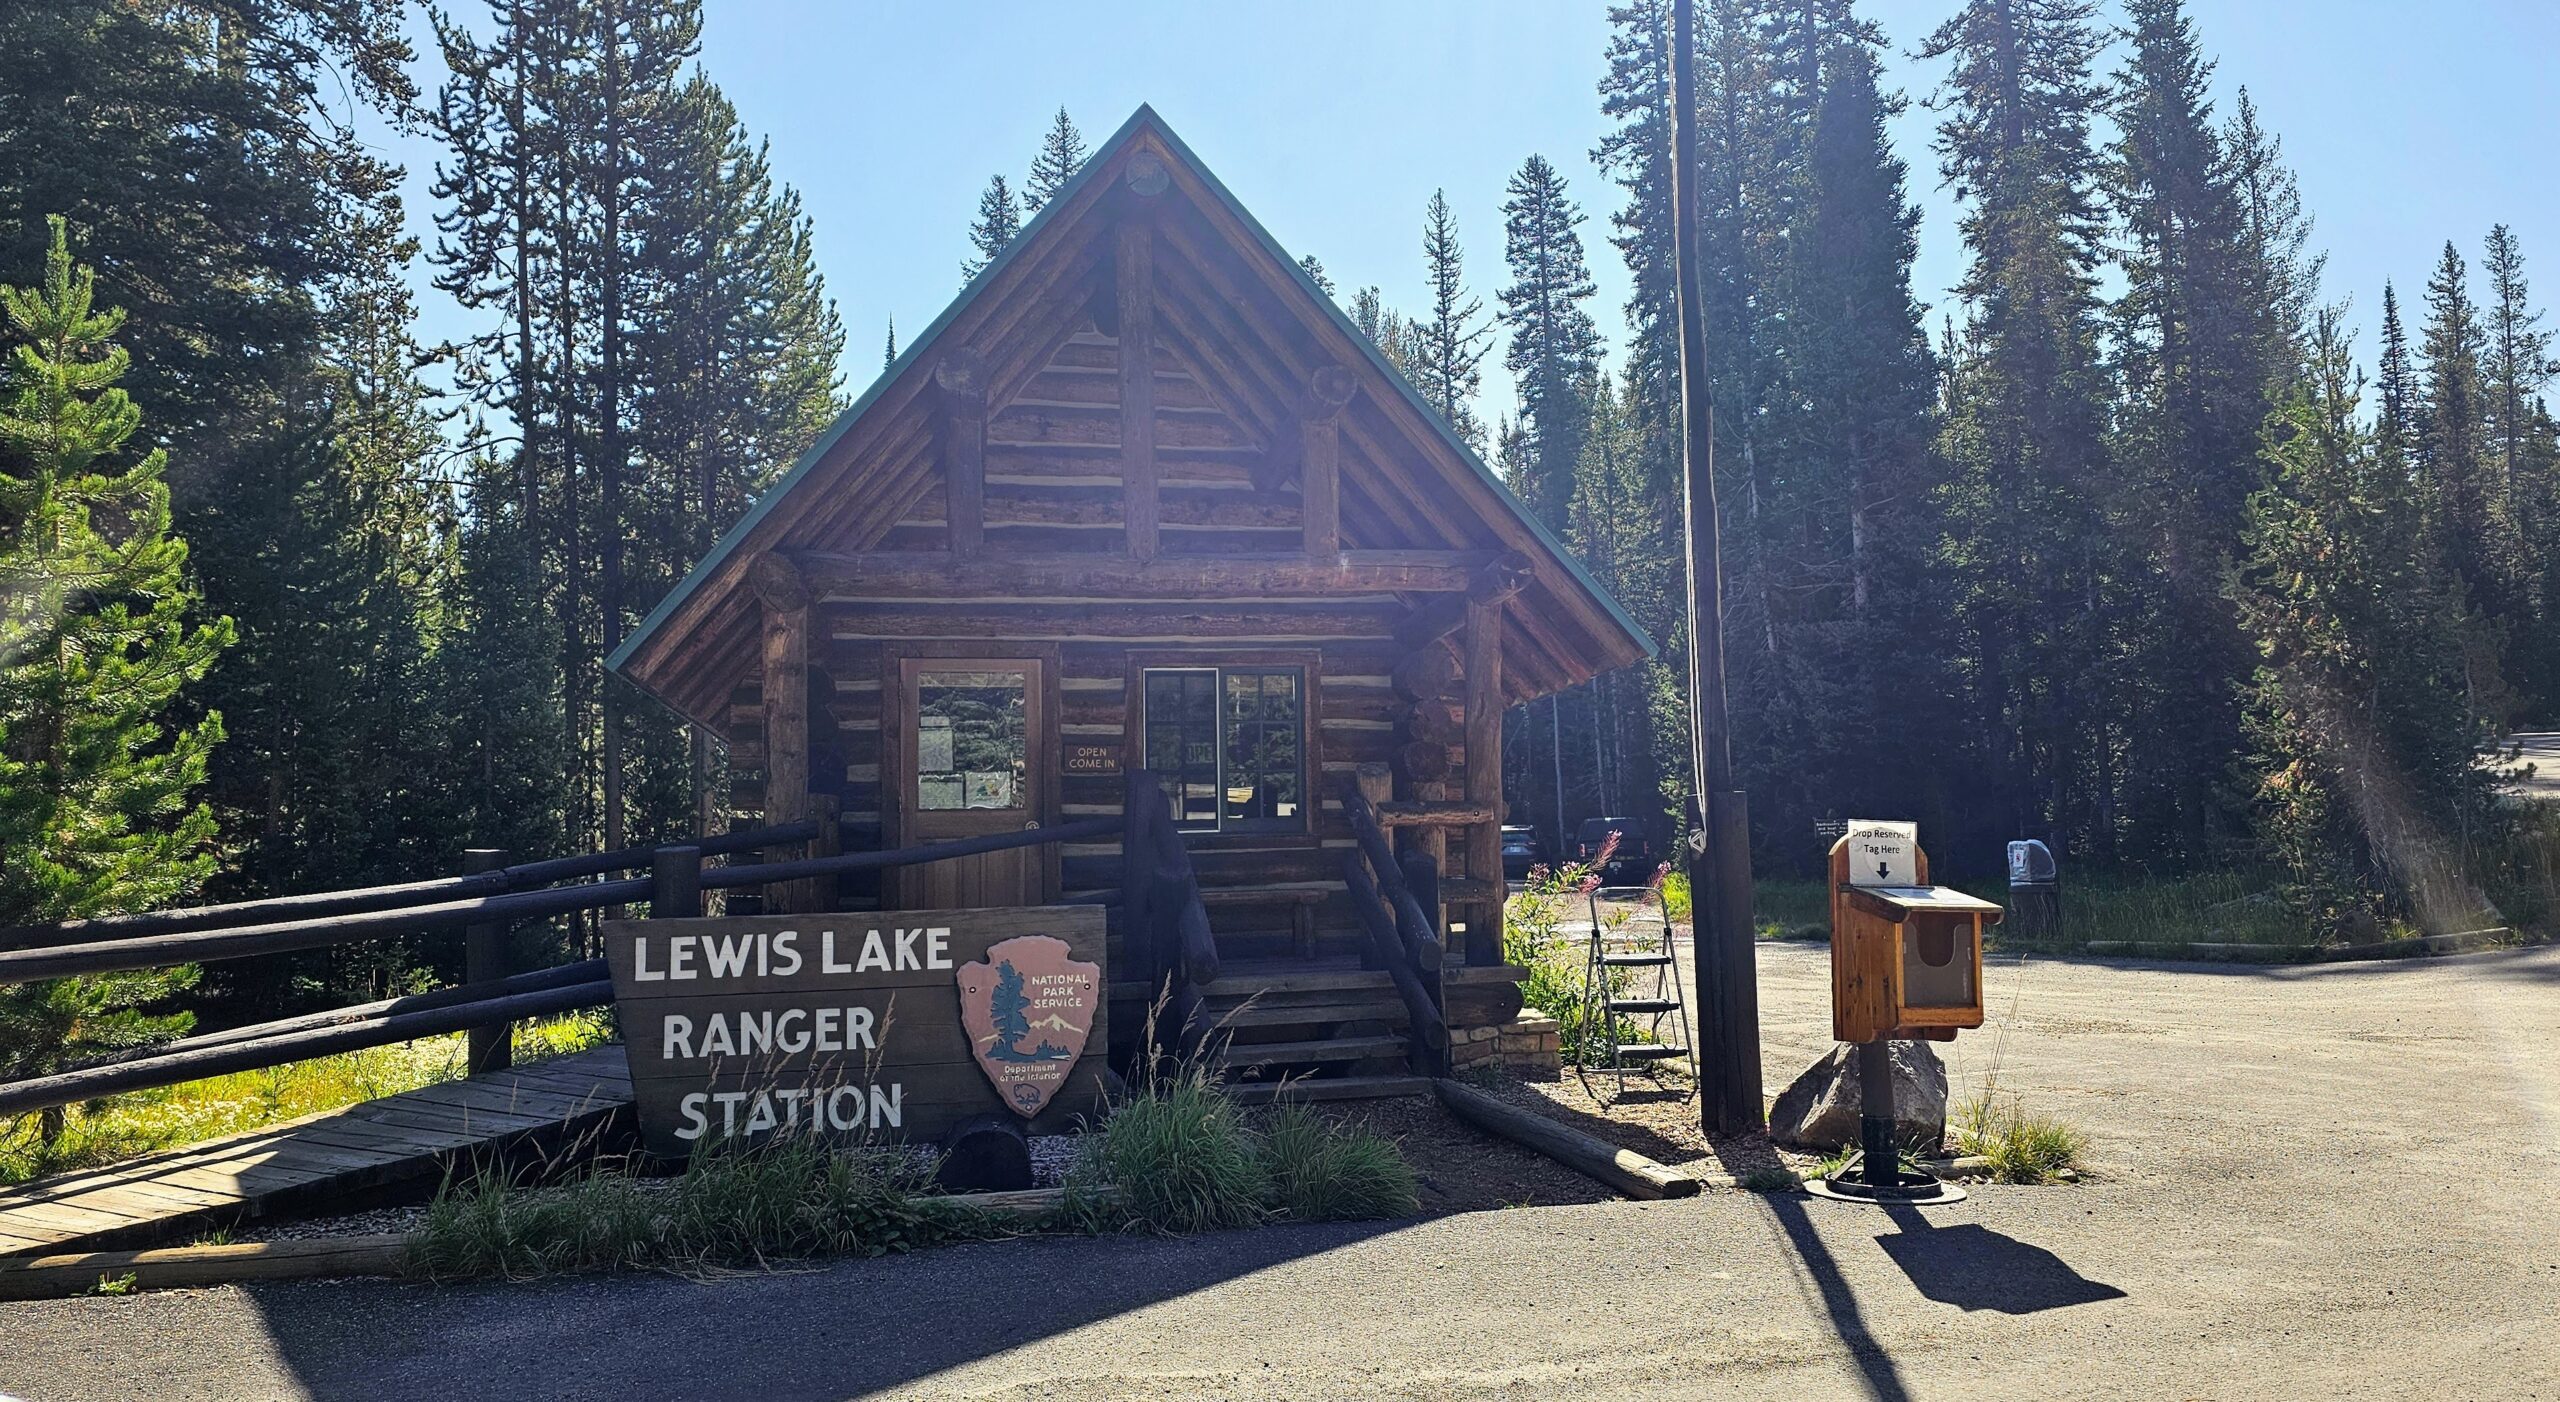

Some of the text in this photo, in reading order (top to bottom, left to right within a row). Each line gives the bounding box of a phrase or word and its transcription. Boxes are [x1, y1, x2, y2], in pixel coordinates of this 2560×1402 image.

[1078, 747, 1107, 757] OPEN
[1069, 759, 1114, 768] COME IN
[1853, 829, 1911, 839] Drop Reserved
[1864, 844, 1900, 855] Tag Here
[635, 927, 953, 981] LEWIS LAKE
[1032, 974, 1088, 984] NATIONAL
[1043, 986, 1074, 996] PARK
[1034, 998, 1082, 1008] SERVICE
[663, 1006, 876, 1060] RANGER
[1004, 1064, 1055, 1074] Department
[674, 1083, 902, 1140] STATION
